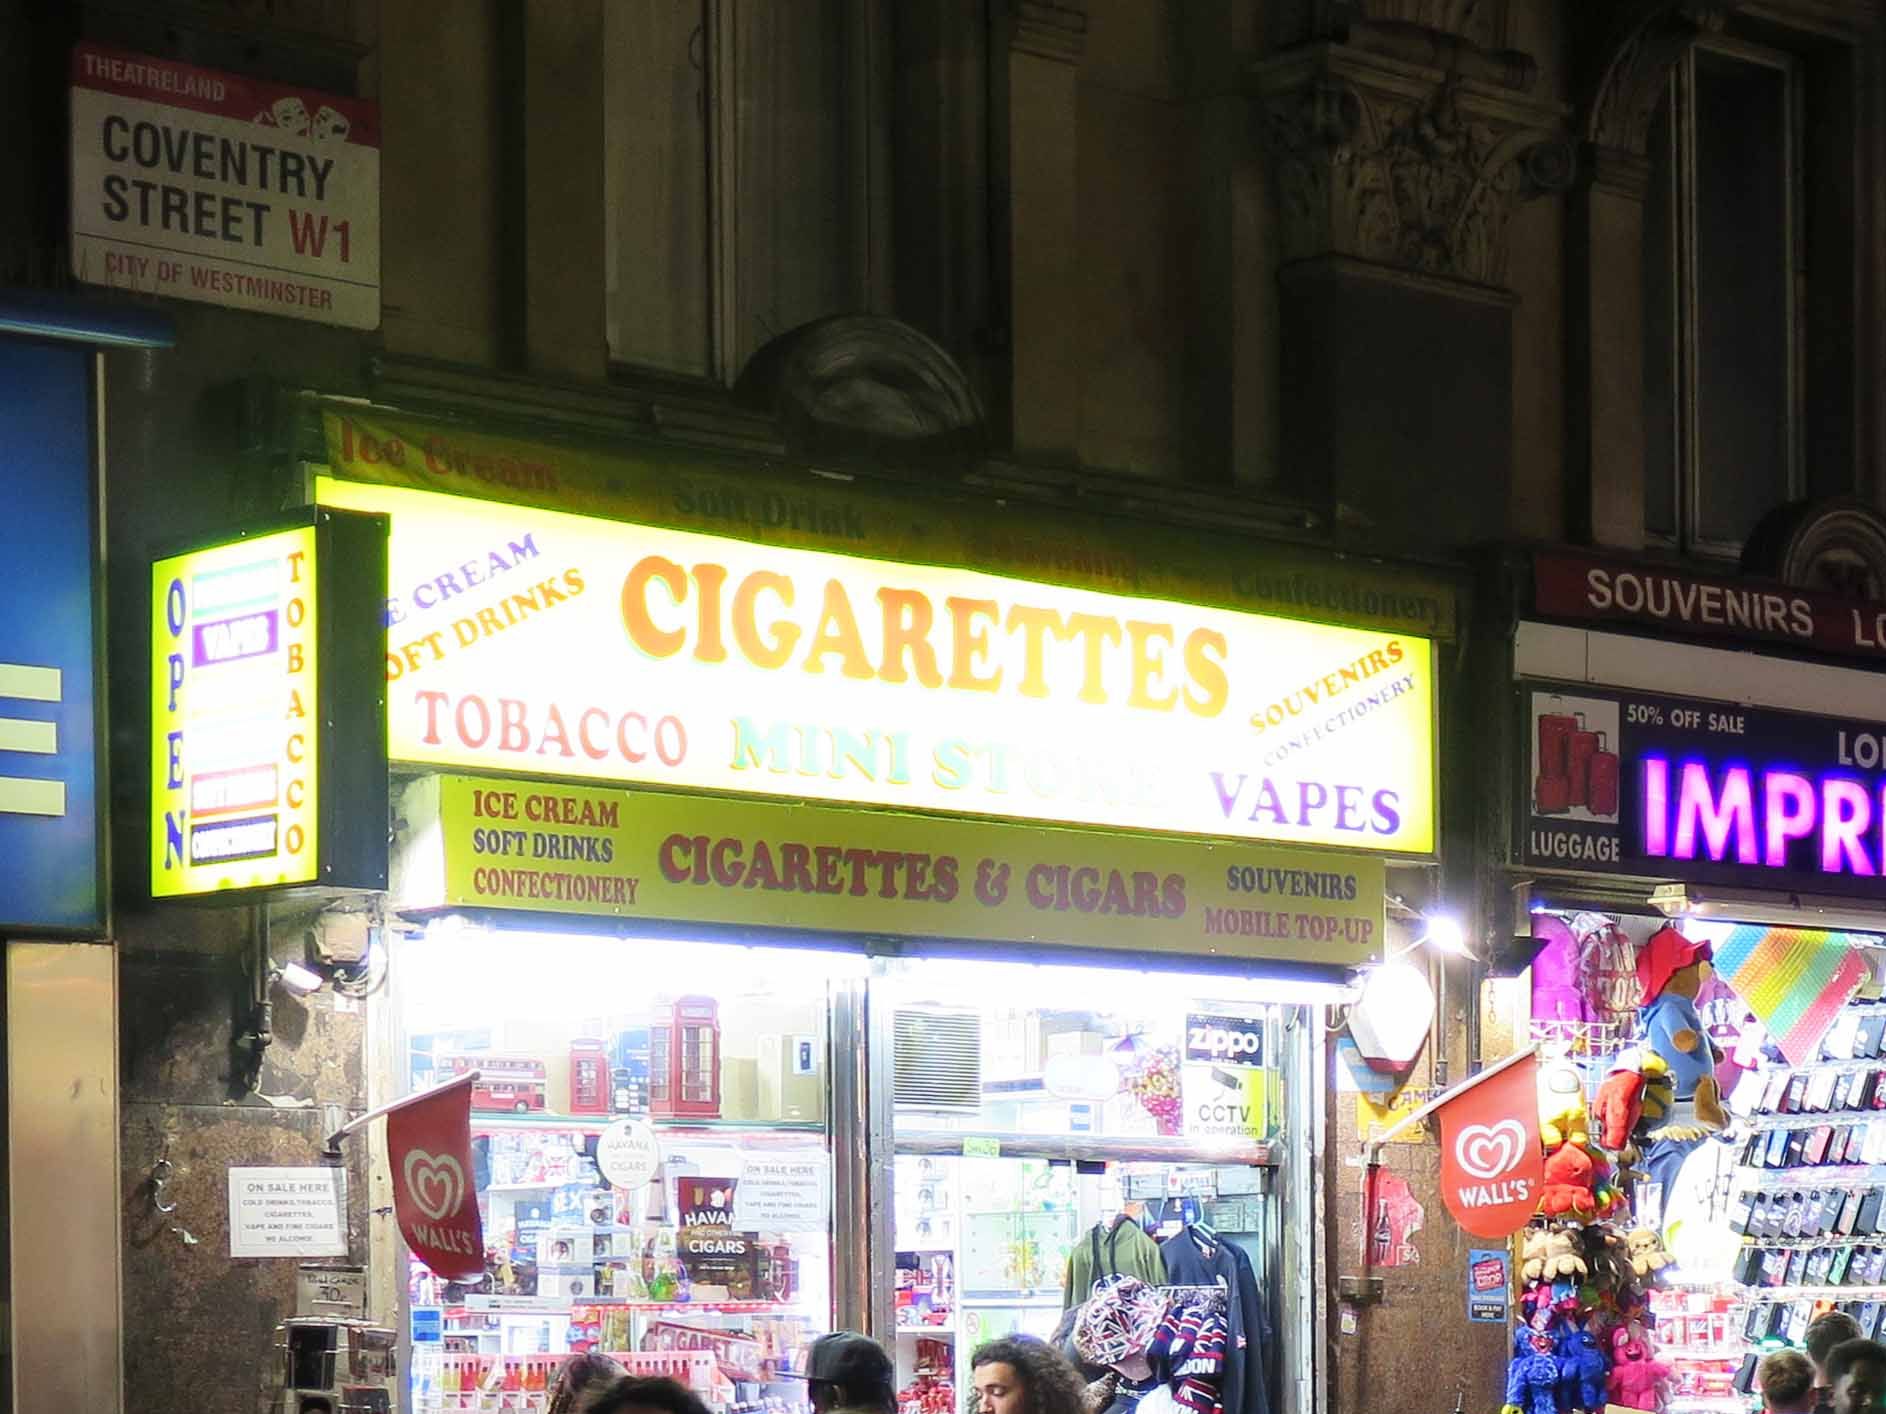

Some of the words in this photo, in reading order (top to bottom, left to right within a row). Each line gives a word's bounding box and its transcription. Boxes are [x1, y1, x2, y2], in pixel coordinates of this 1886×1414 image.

[83, 53, 225, 102] THEATRELAND
[102, 115, 334, 201] COVENTRY
[103, 175, 271, 247] STREET
[289, 208, 352, 264] W1
[104, 252, 150, 280] CITY
[157, 260, 183, 285] OF
[190, 266, 332, 311] WESTMINSTER
[411, 532, 541, 611] CREAM
[388, 630, 447, 683] OFT
[452, 567, 586, 650] DRINKS
[1587, 568, 1814, 638] SOUVENIRS
[619, 553, 1230, 717] CIGARETTES
[285, 550, 306, 857] TOBACCO
[1249, 640, 1405, 736] SOUVENIRS
[164, 577, 187, 872] OPEN
[415, 690, 688, 767] TOBACCO
[1627, 703, 1664, 728] 50%
[1670, 709, 1703, 731] OFF
[1707, 712, 1745, 736] SALE
[728, 713, 913, 790] MINI
[473, 790, 518, 820] ICE
[525, 795, 619, 830] CREAM
[1208, 770, 1402, 837] VAPES
[473, 829, 525, 859] SOFT
[531, 833, 614, 864] DRINKS
[1530, 830, 1621, 864] LUGGAGE
[473, 867, 639, 905] CONFECTIONERY
[659, 834, 959, 903] CIGARETTES
[975, 859, 1011, 905] &
[1026, 864, 1187, 919] CIGARS
[1227, 864, 1356, 902] SOUVENIRS
[1204, 905, 1290, 941] MOBILE
[1295, 909, 1373, 944] TOP-UP
[1188, 1024, 1259, 1057] zippo
[1199, 1104, 1251, 1122] CCTV
[1204, 1124, 1258, 1136] operation
[247, 1183, 264, 1192] ON
[267, 1184, 296, 1192] SALE
[299, 1184, 329, 1192] HERE
[1458, 1179, 1529, 1208] WALL'S
[411, 1224, 473, 1255] WALL'S
[689, 1241, 745, 1255] CIGARS
